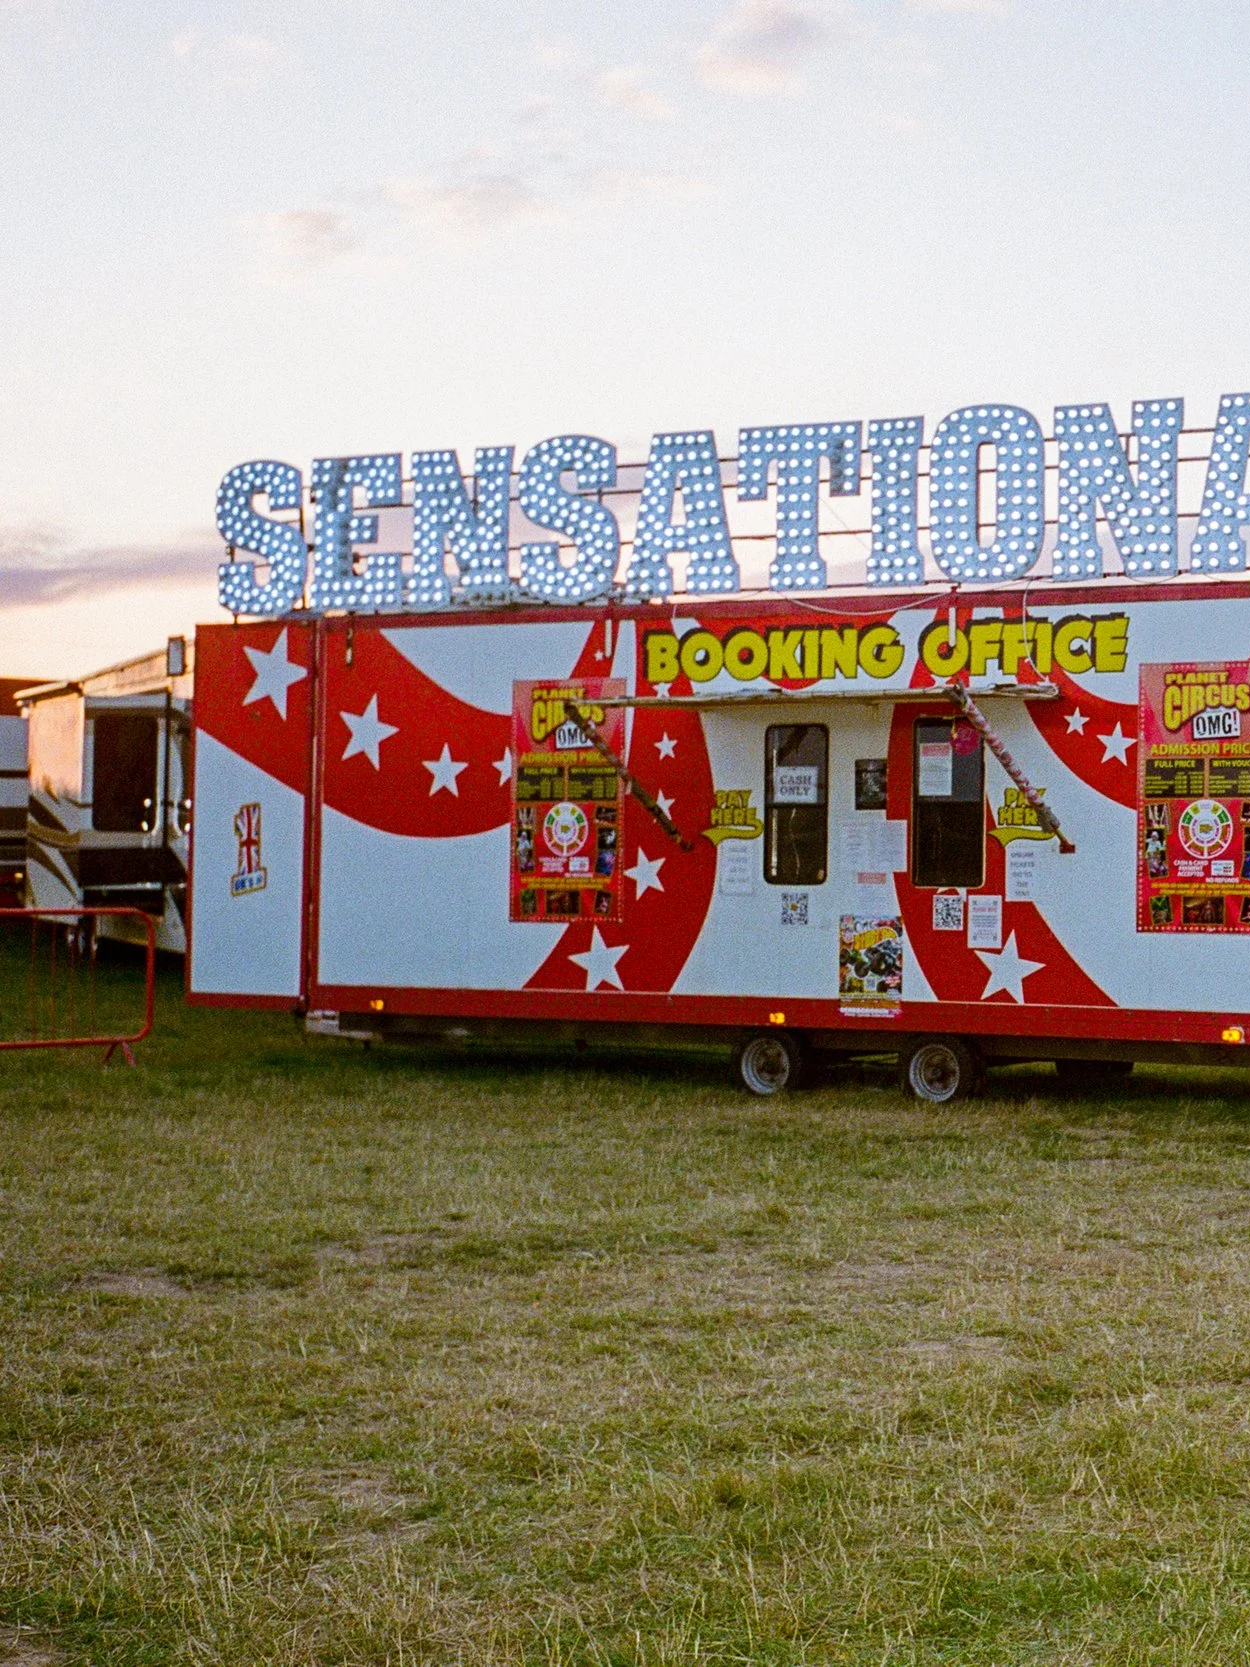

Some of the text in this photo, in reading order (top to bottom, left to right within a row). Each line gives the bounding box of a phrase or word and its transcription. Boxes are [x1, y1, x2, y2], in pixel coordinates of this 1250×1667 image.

[644, 612, 1130, 682] BOOKING OFFICE
[1164, 671, 1229, 685] PLANET
[532, 687, 585, 700] PLANET
[532, 700, 605, 741] CIRUS
[1195, 711, 1239, 736] OMG!
[1151, 743, 1220, 755] ADMISSION
[780, 775, 812, 785] CASH
[715, 789, 752, 809] PAY
[780, 786, 811, 796] ONLY
[710, 807, 757, 826] HERE
[998, 806, 1041, 826] HER
